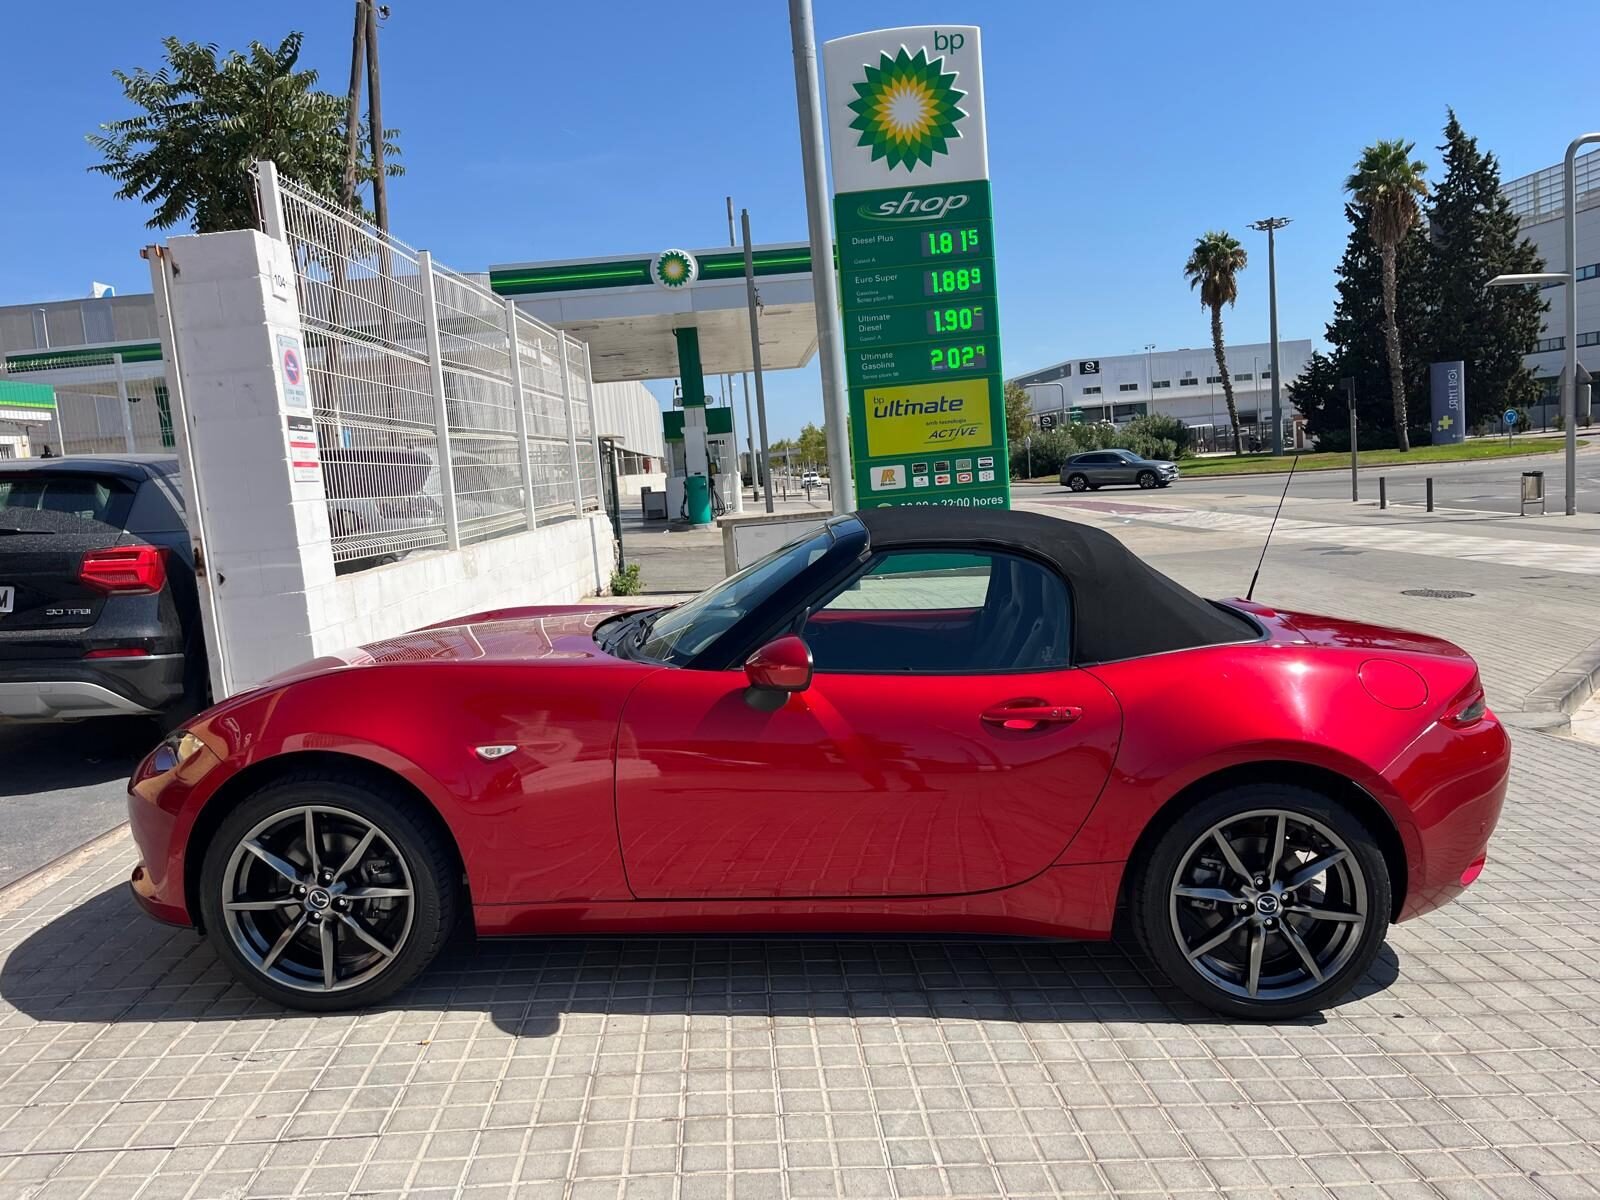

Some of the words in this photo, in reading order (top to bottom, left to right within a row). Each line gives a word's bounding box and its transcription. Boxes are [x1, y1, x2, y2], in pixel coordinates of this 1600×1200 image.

[934, 31, 964, 54] bp
[879, 191, 970, 218] shop
[852, 236, 875, 244] Diesel
[855, 276, 873, 284] Euro
[875, 274, 897, 282] Super
[932, 268, 980, 293] 1.889
[858, 314, 891, 322] Ultimate
[858, 323, 882, 332] Diesel
[862, 362, 895, 370] Gasolina
[873, 397, 884, 405] bp
[874, 396, 963, 418] ultimate
[928, 427, 978, 439] ACTIVE
[973, 496, 1004, 507] hores
